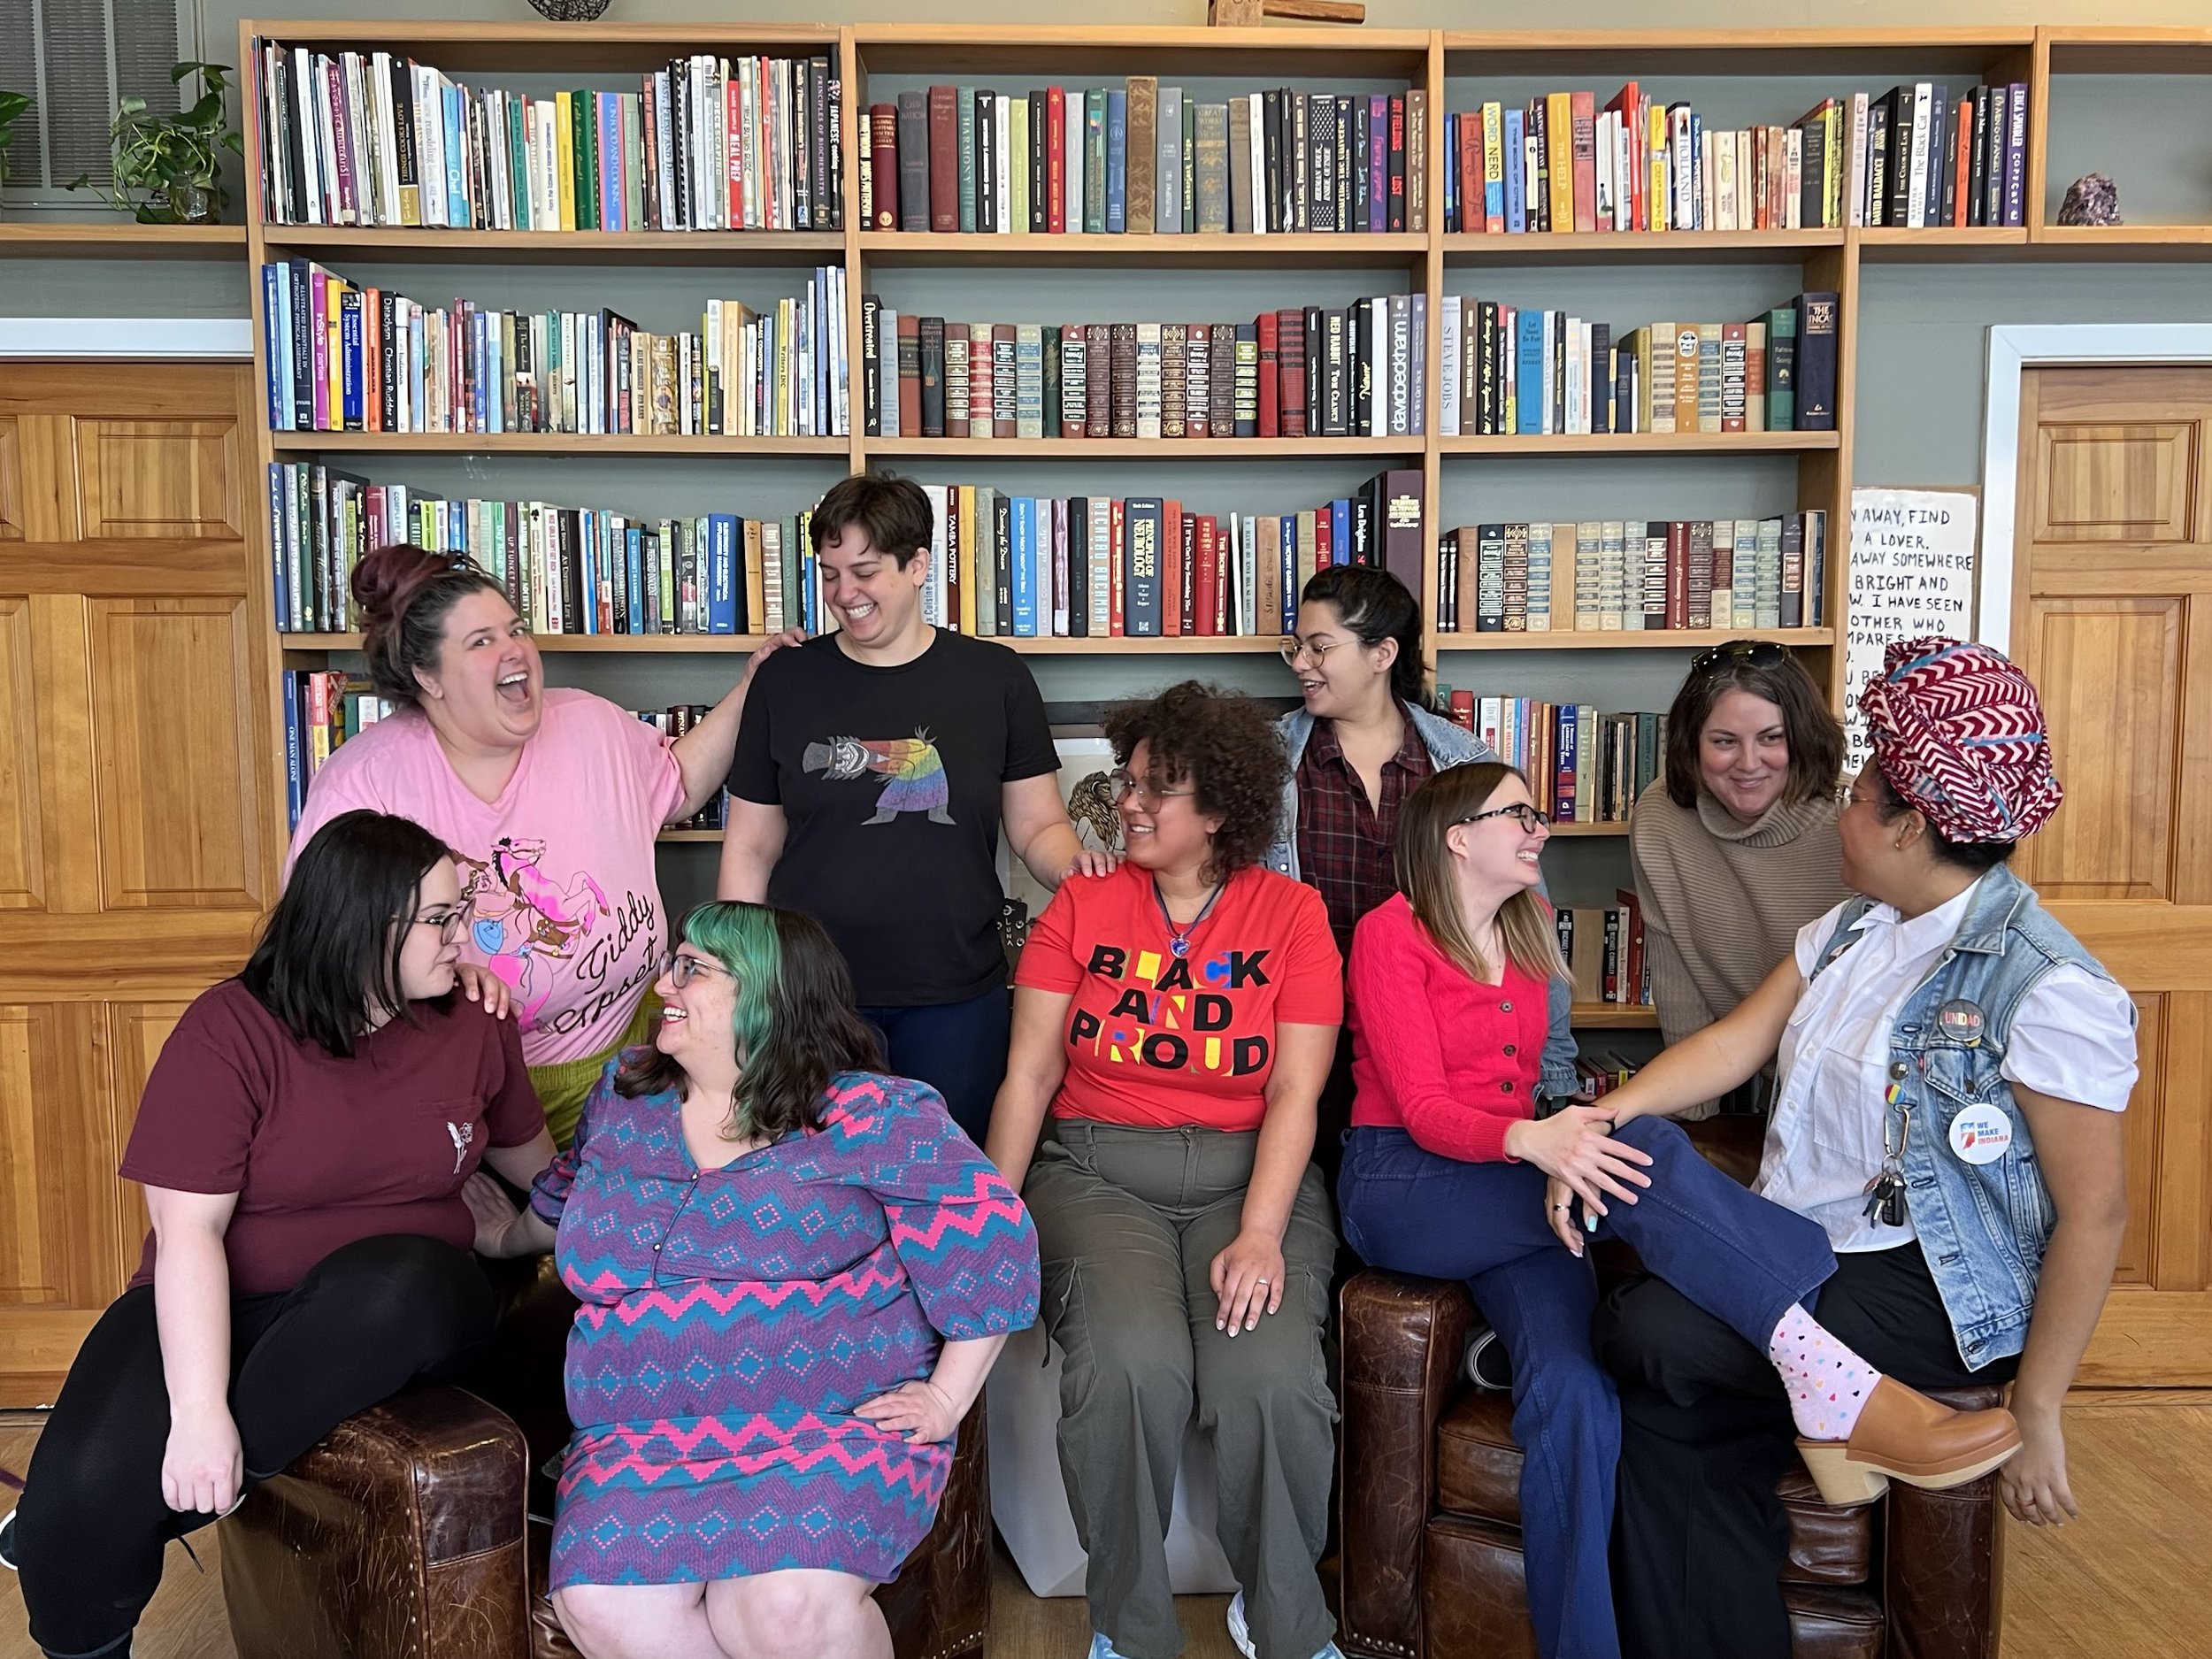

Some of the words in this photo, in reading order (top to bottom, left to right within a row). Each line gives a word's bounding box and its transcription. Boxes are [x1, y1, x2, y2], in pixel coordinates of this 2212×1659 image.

[1977, 96, 1985, 117] Lucky
[818, 124, 824, 134] OF
[829, 105, 840, 143] JAPANESE
[1392, 115, 1402, 151] FIELDING
[1486, 106, 1497, 142] WORD
[1917, 115, 1927, 130] Cat
[398, 127, 407, 154] COOKS
[729, 134, 740, 157] MEAL
[1916, 133, 1926, 156] Black
[730, 160, 741, 181] PREP
[1489, 147, 1499, 180] NERD
[1557, 161, 1566, 189] HELP
[1679, 139, 1690, 202] HOLLAND
[1915, 159, 1924, 176] The
[449, 169, 460, 194] Chef
[611, 165, 620, 207] COOKING
[1392, 176, 1402, 196] LOST
[1513, 173, 1518, 184] OF
[1873, 157, 1885, 199] BALDACCI
[1872, 200, 1883, 225] DAVID
[383, 297, 392, 340] Dataclysm
[1812, 306, 1830, 315] THE
[316, 312, 325, 346] InStyle
[864, 302, 877, 359] Overtreated
[1330, 316, 1340, 334] RED
[1330, 334, 1340, 365] RABBIT
[1442, 326, 1454, 373] STEVE
[1331, 370, 1340, 388] TOM
[1441, 375, 1453, 410] JOBS
[385, 385, 394, 416] Rudder
[1331, 390, 1340, 423] CLANCY
[1094, 502, 1108, 559] RICHARD
[1862, 509, 1904, 527] AWAY,
[1909, 510, 1950, 526] FIND
[508, 536, 513, 548] UP
[1133, 518, 1145, 578] NEUROLOGY
[1145, 518, 1155, 565] PRINCIPLES
[1355, 519, 1367, 552] Deighton
[1864, 532, 1872, 545] A
[1881, 533, 1929, 549] LOVER.
[561, 555, 568, 565] AN
[1146, 565, 1155, 577] OF
[1851, 552, 1886, 566] AWAY
[1892, 552, 1973, 571] SOMEWHERE
[316, 556, 325, 593] Manger
[1855, 575, 1915, 591] BRIGHT
[1918, 576, 1948, 591] AND
[924, 586, 933, 615] Cuisine
[1094, 566, 1108, 622] BACHMAN
[1872, 595, 1882, 608] I
[1888, 596, 1920, 609] HAVE
[1926, 598, 1962, 612] SEEN
[1851, 615, 1902, 630] OTHER
[1913, 618, 1946, 633] WHO
[577, 890, 655, 995] Giddy
[1005, 917, 1014, 947] LUNA
[1108, 988, 1233, 1032] AND
[1945, 1011, 1980, 1027] UNIDAD
[1069, 1007, 1269, 1077] PROUD
[1978, 1134, 2008, 1145] INDIANA
